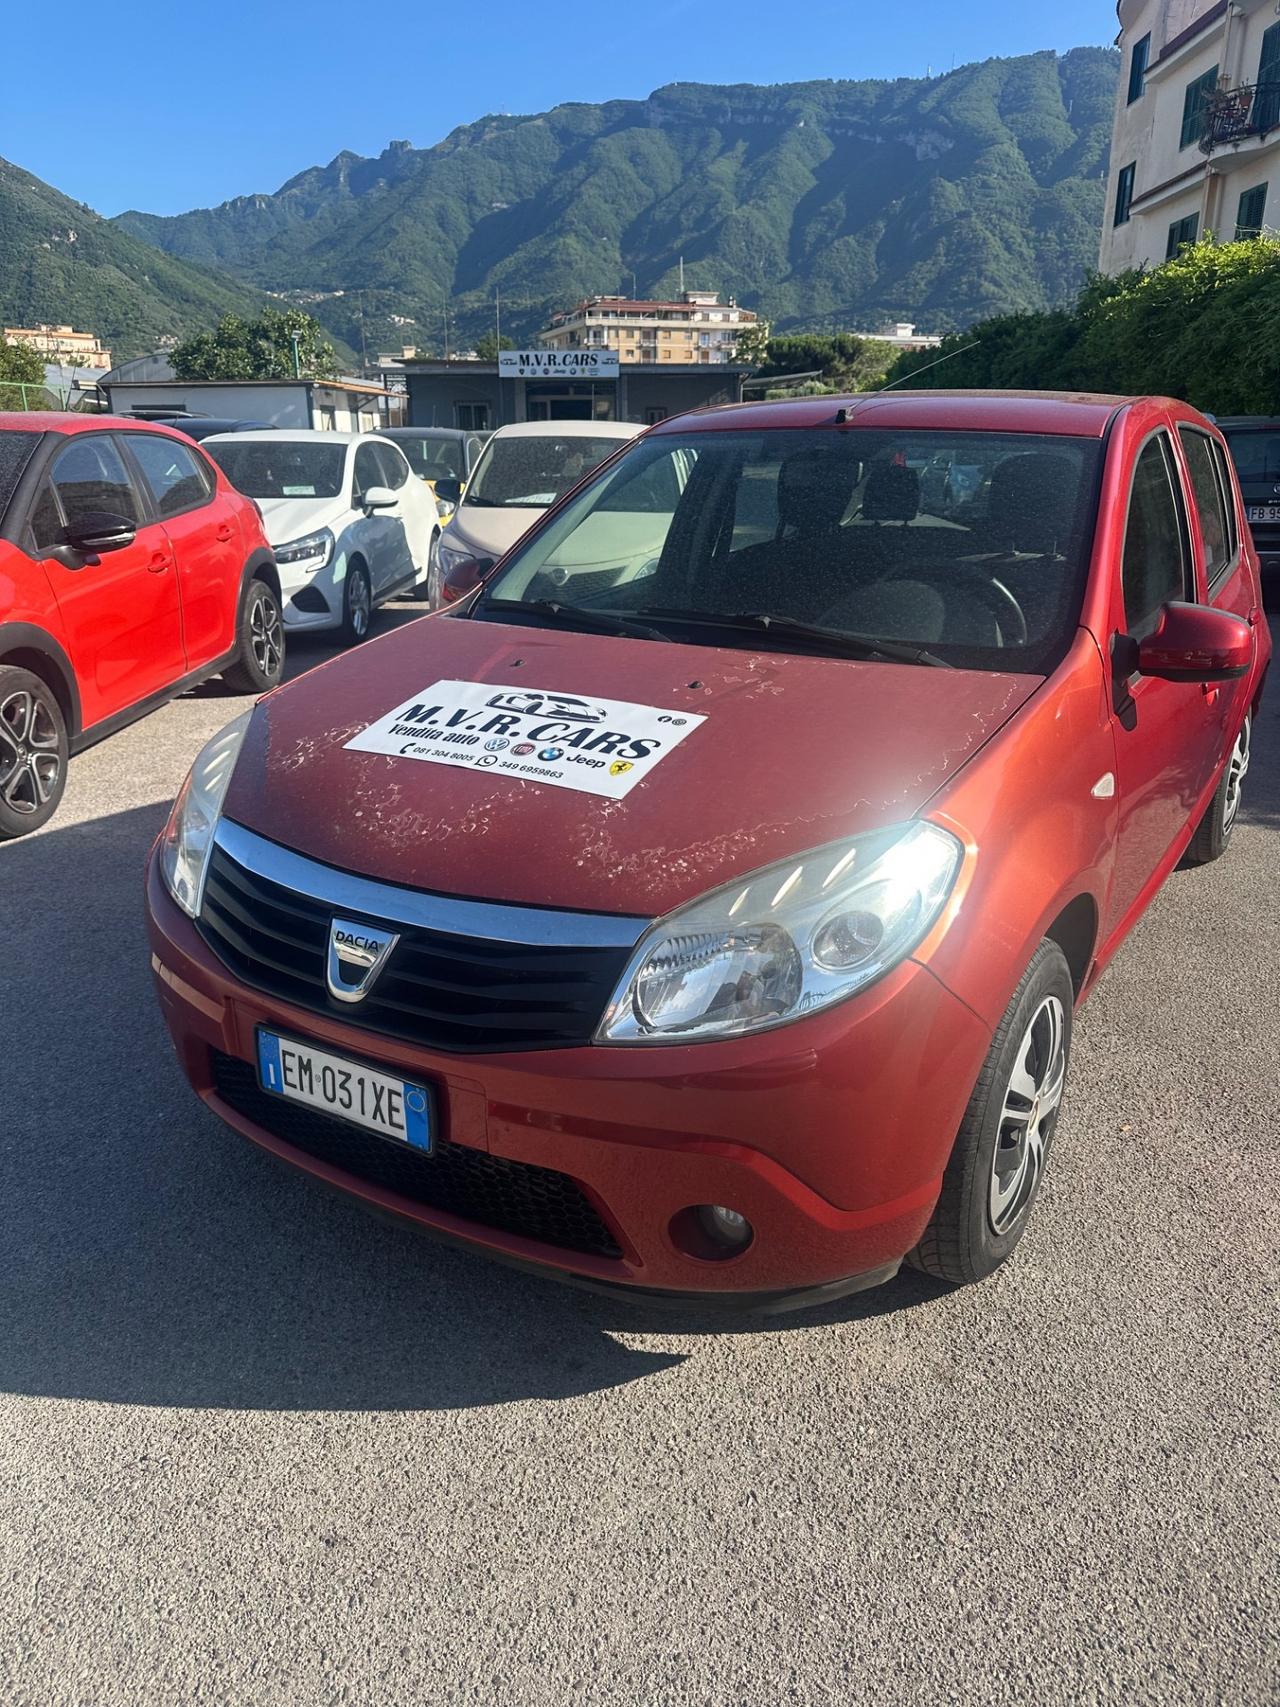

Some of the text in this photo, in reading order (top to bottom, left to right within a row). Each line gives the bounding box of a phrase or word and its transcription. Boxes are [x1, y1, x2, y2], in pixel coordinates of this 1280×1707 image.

[389, 724, 480, 746] Vendita auto
[413, 746, 475, 762] 081 304 8005
[566, 754, 606, 769] Jeep
[499, 761, 564, 779] 349 6959863
[336, 930, 379, 952] DACIA
